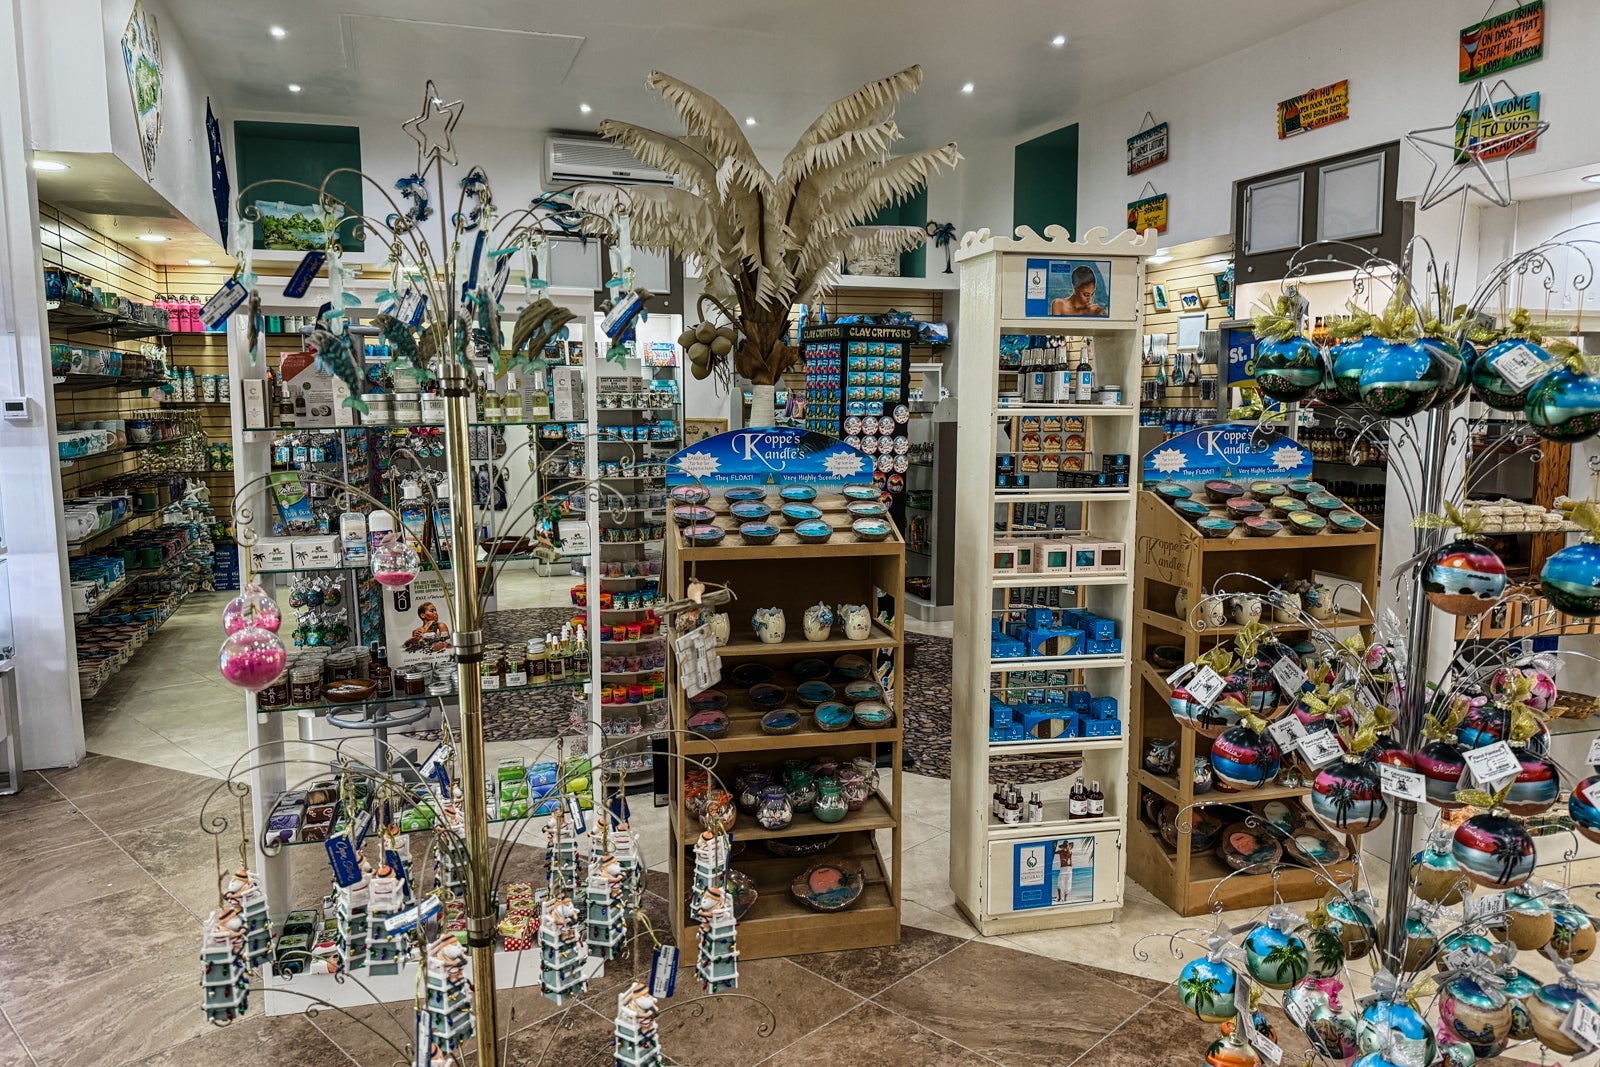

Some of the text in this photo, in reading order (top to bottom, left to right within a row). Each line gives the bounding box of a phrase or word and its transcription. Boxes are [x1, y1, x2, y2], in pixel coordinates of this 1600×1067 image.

[1493, 13, 1513, 29] ONLY
[1515, 5, 1540, 22] DRINK
[1482, 33, 1493, 47] ON
[1495, 26, 1513, 42] DAYS
[1517, 16, 1541, 34] THAT
[1478, 36, 1523, 62] START WITH
[1320, 84, 1336, 98] HUT
[1481, 115, 1531, 138] TO OUR
[804, 327, 840, 339] CLAY CRITTERS
[849, 327, 912, 339] CLAY CRITTERS
[1183, 468, 1215, 477] They FLOAT!
[1238, 468, 1250, 476] Very
[1250, 467, 1266, 476] Highly
[715, 474, 729, 483] They
[783, 473, 841, 483] Very Highly Scented
